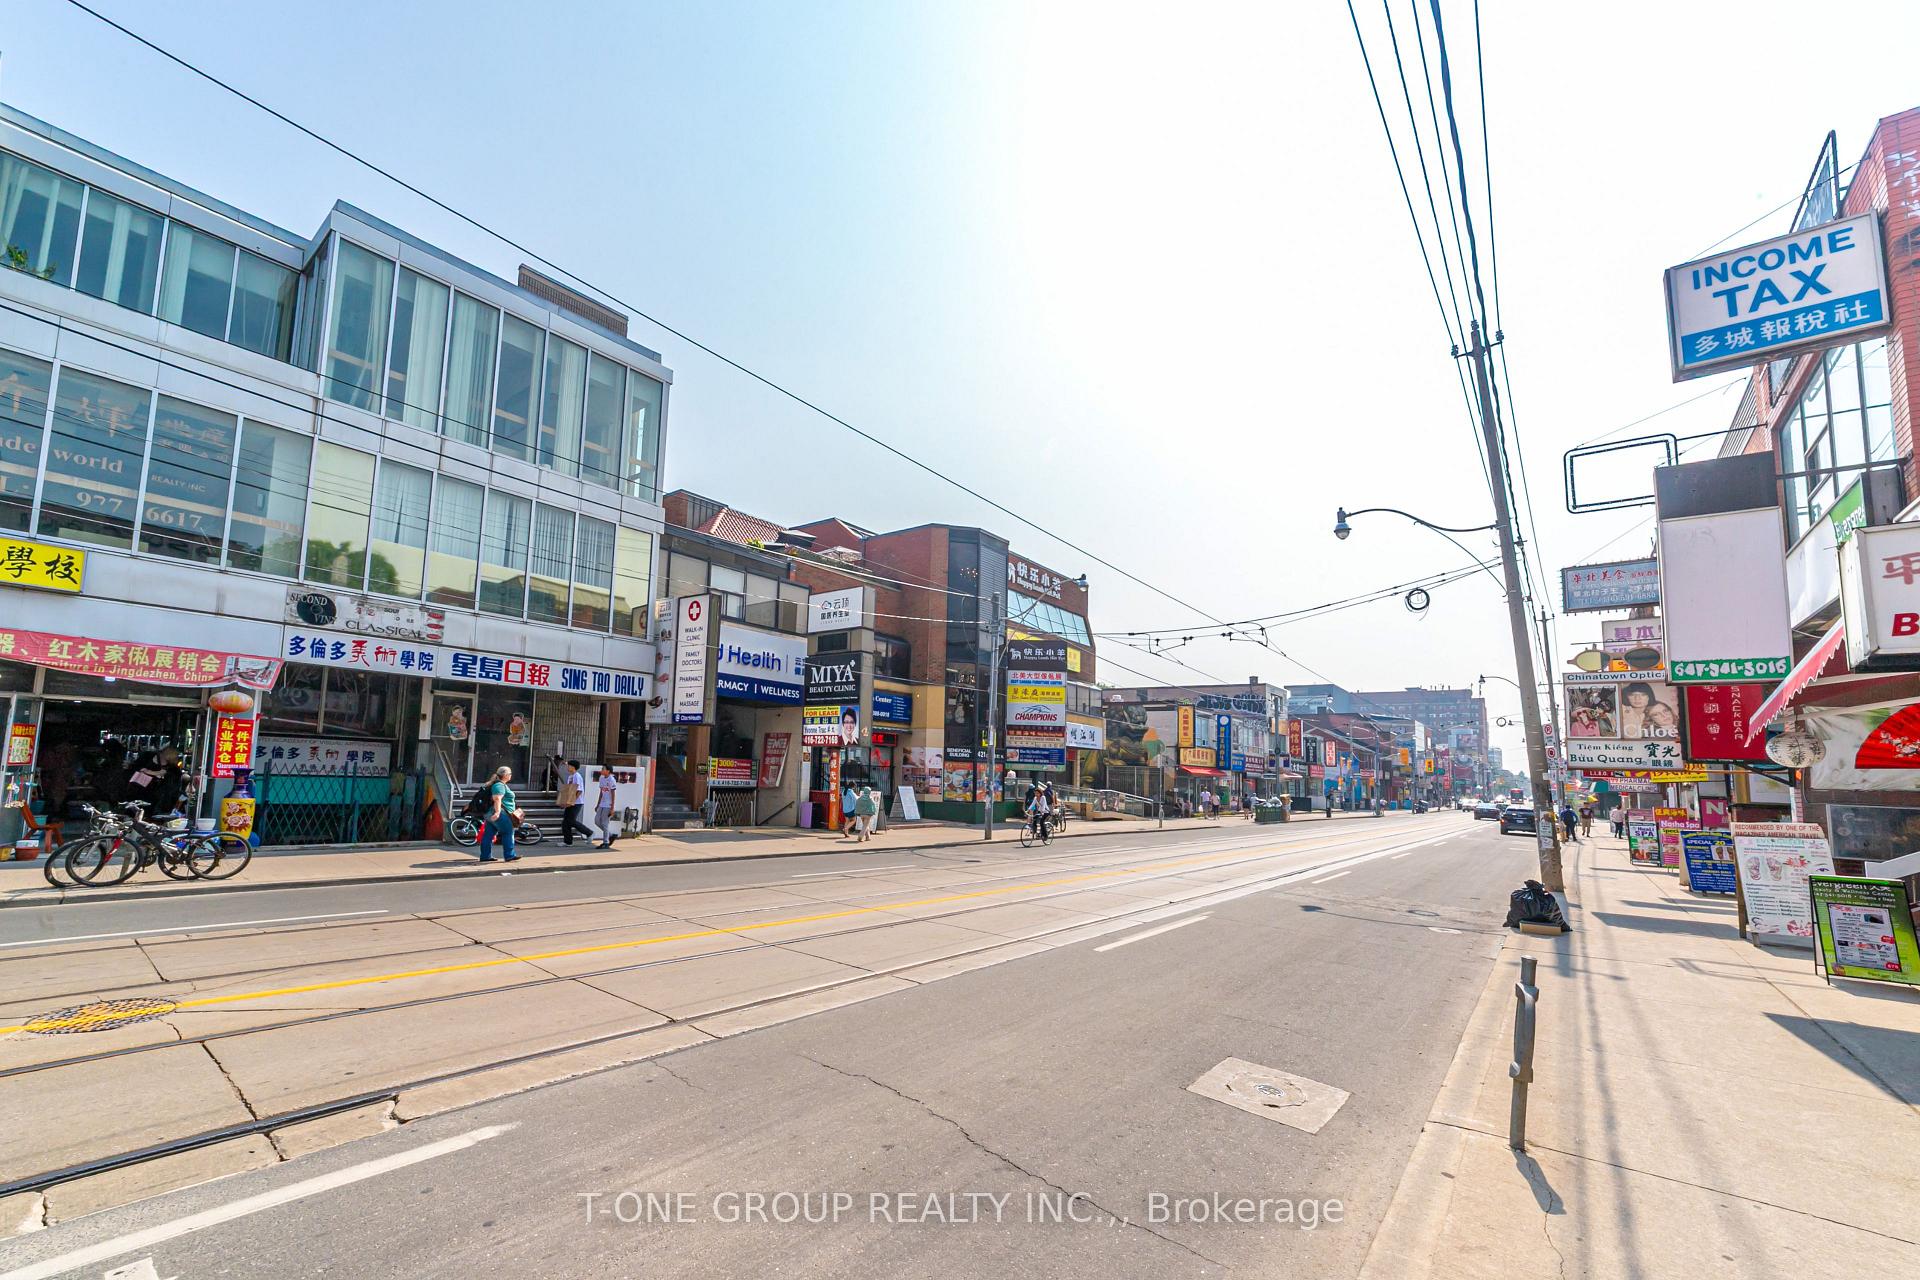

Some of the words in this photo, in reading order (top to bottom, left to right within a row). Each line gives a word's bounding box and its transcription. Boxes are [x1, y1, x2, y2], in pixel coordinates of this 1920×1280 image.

[1692, 227, 1855, 290] INCOME
[1713, 263, 1832, 318] TAX
[1695, 301, 1870, 357] 多城報稅社
[53, 449, 123, 473] world
[76, 491, 122, 513] 977
[146, 505, 201, 530] 6617
[290, 592, 328, 606] SECOND
[289, 635, 433, 671] 多倫多美術學院
[682, 658, 702, 666] DOCTORS
[728, 645, 781, 671] Health
[94, 663, 105, 673] in
[109, 664, 179, 681] Jingdezhen,
[184, 671, 214, 682] China
[451, 653, 550, 687] 星島日報
[811, 664, 855, 684] MIYA
[1567, 673, 1626, 681] Chinatown
[561, 667, 587, 691] SING
[592, 672, 610, 693] TAO
[614, 674, 644, 696] DAILY
[834, 684, 856, 692] CLINIC
[761, 685, 799, 698] WELLNESS
[875, 693, 893, 703] Center
[1731, 686, 1741, 718] SNACK
[1015, 713, 1058, 722] CHAMPIONS
[1733, 721, 1743, 740] BAR
[1597, 754, 1643, 765] Quang
[1644, 743, 1680, 758] 寶光
[1610, 784, 1637, 792] MEDICAL
[1637, 784, 1658, 792] CLINIC
[1660, 820, 1685, 828] Nasha
[1685, 821, 1700, 829] Spa
